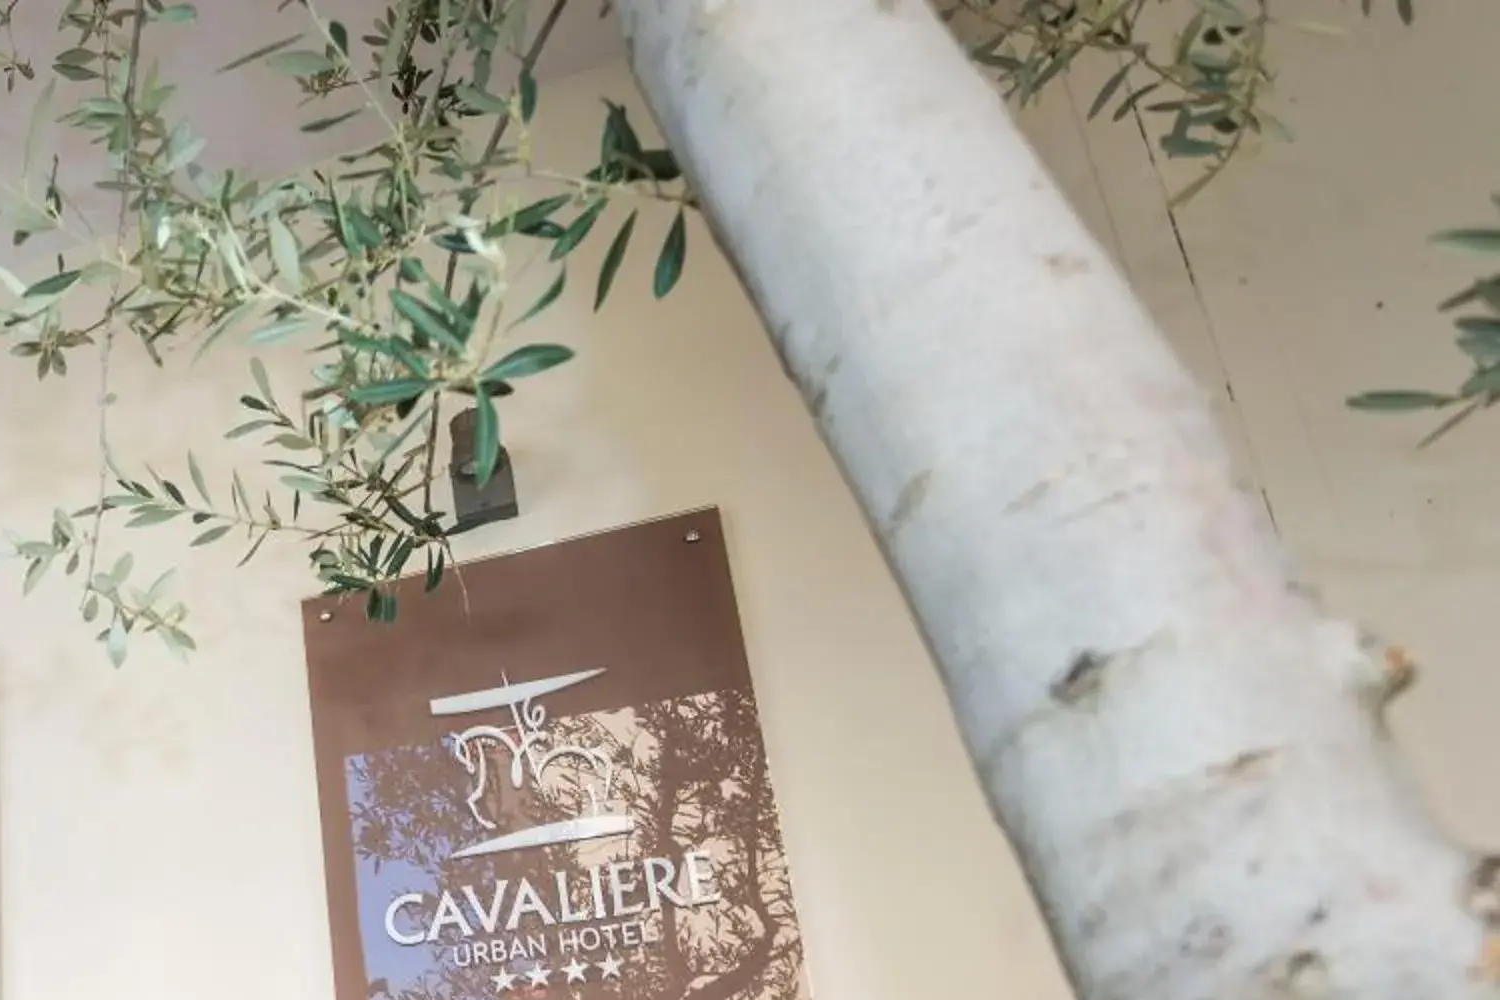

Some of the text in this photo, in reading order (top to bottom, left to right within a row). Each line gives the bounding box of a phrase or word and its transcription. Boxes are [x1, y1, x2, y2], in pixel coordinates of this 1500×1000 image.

[384, 850, 722, 946] CAVALIERE
[453, 919, 661, 968] URBAN HOTEL
